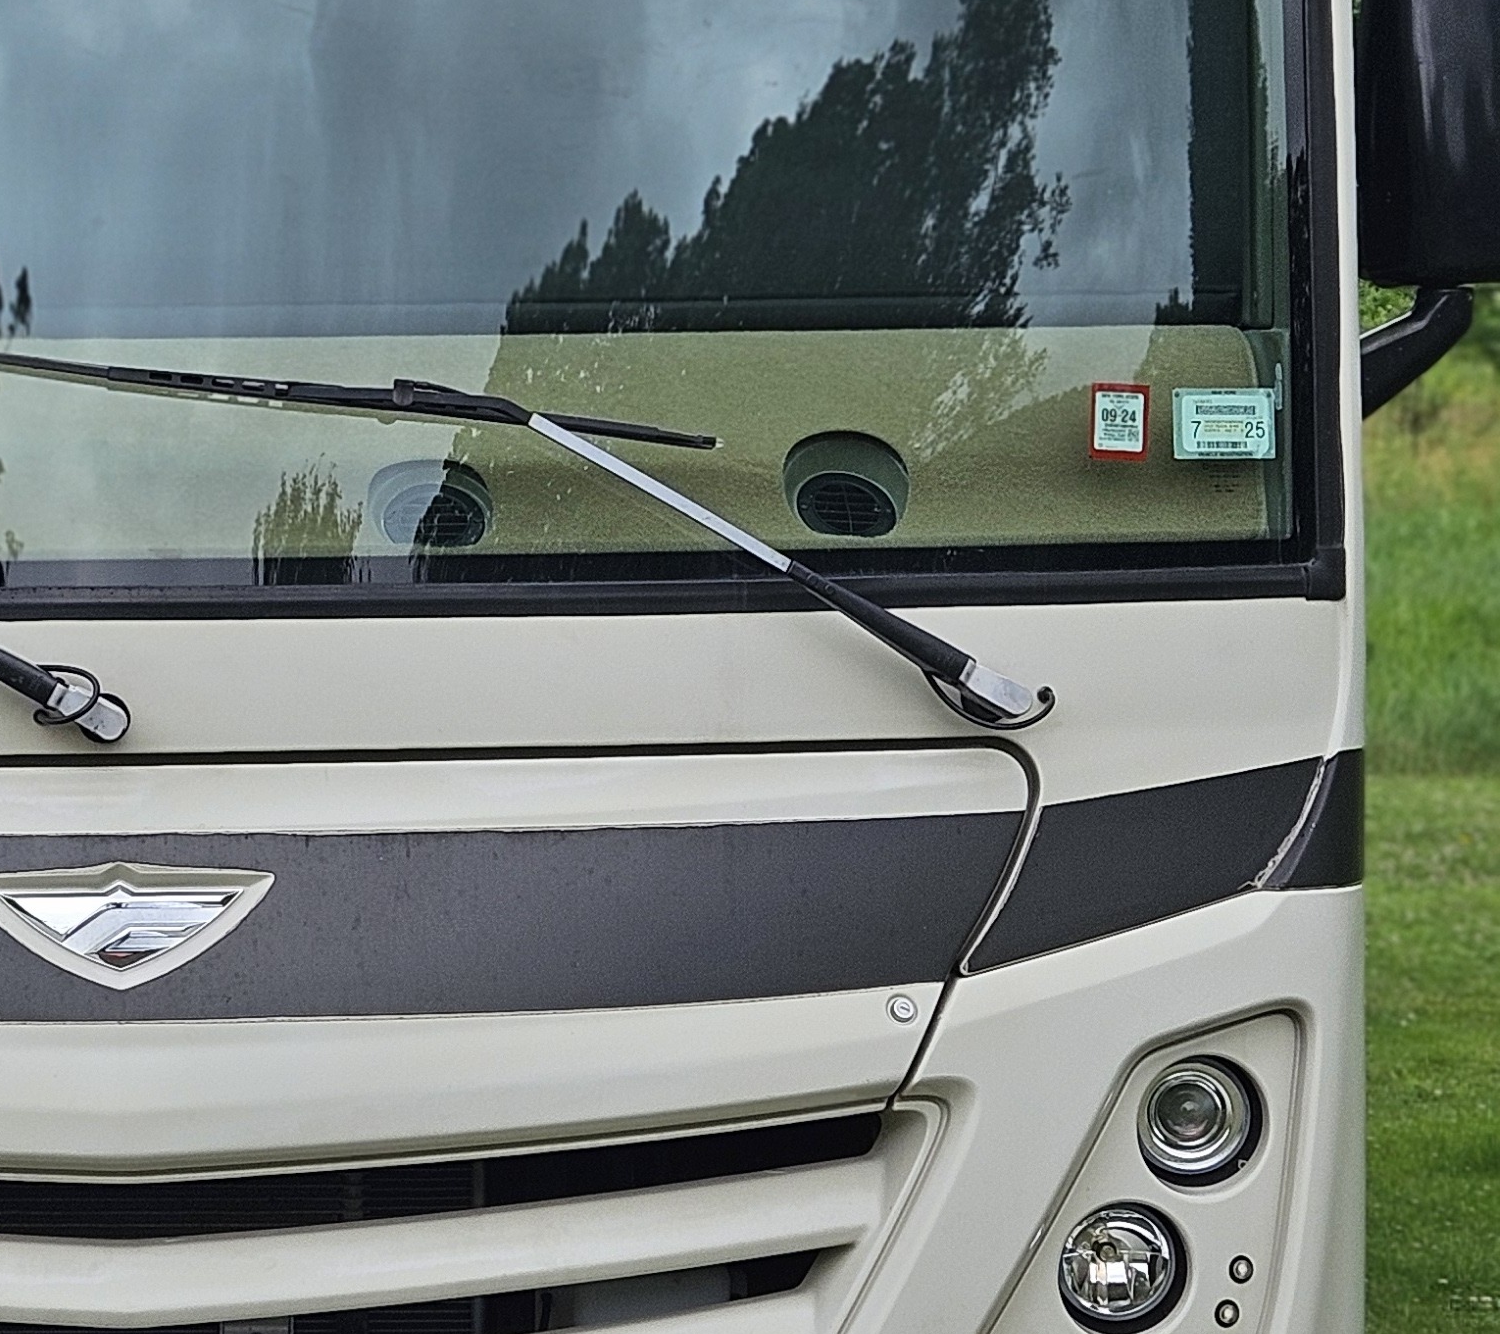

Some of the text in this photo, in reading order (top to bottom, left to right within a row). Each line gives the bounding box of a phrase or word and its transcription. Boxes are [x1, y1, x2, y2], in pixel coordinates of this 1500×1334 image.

[1101, 407, 1137, 423] 09-24
[1190, 420, 1202, 439] 7
[1244, 420, 1266, 439] 25
